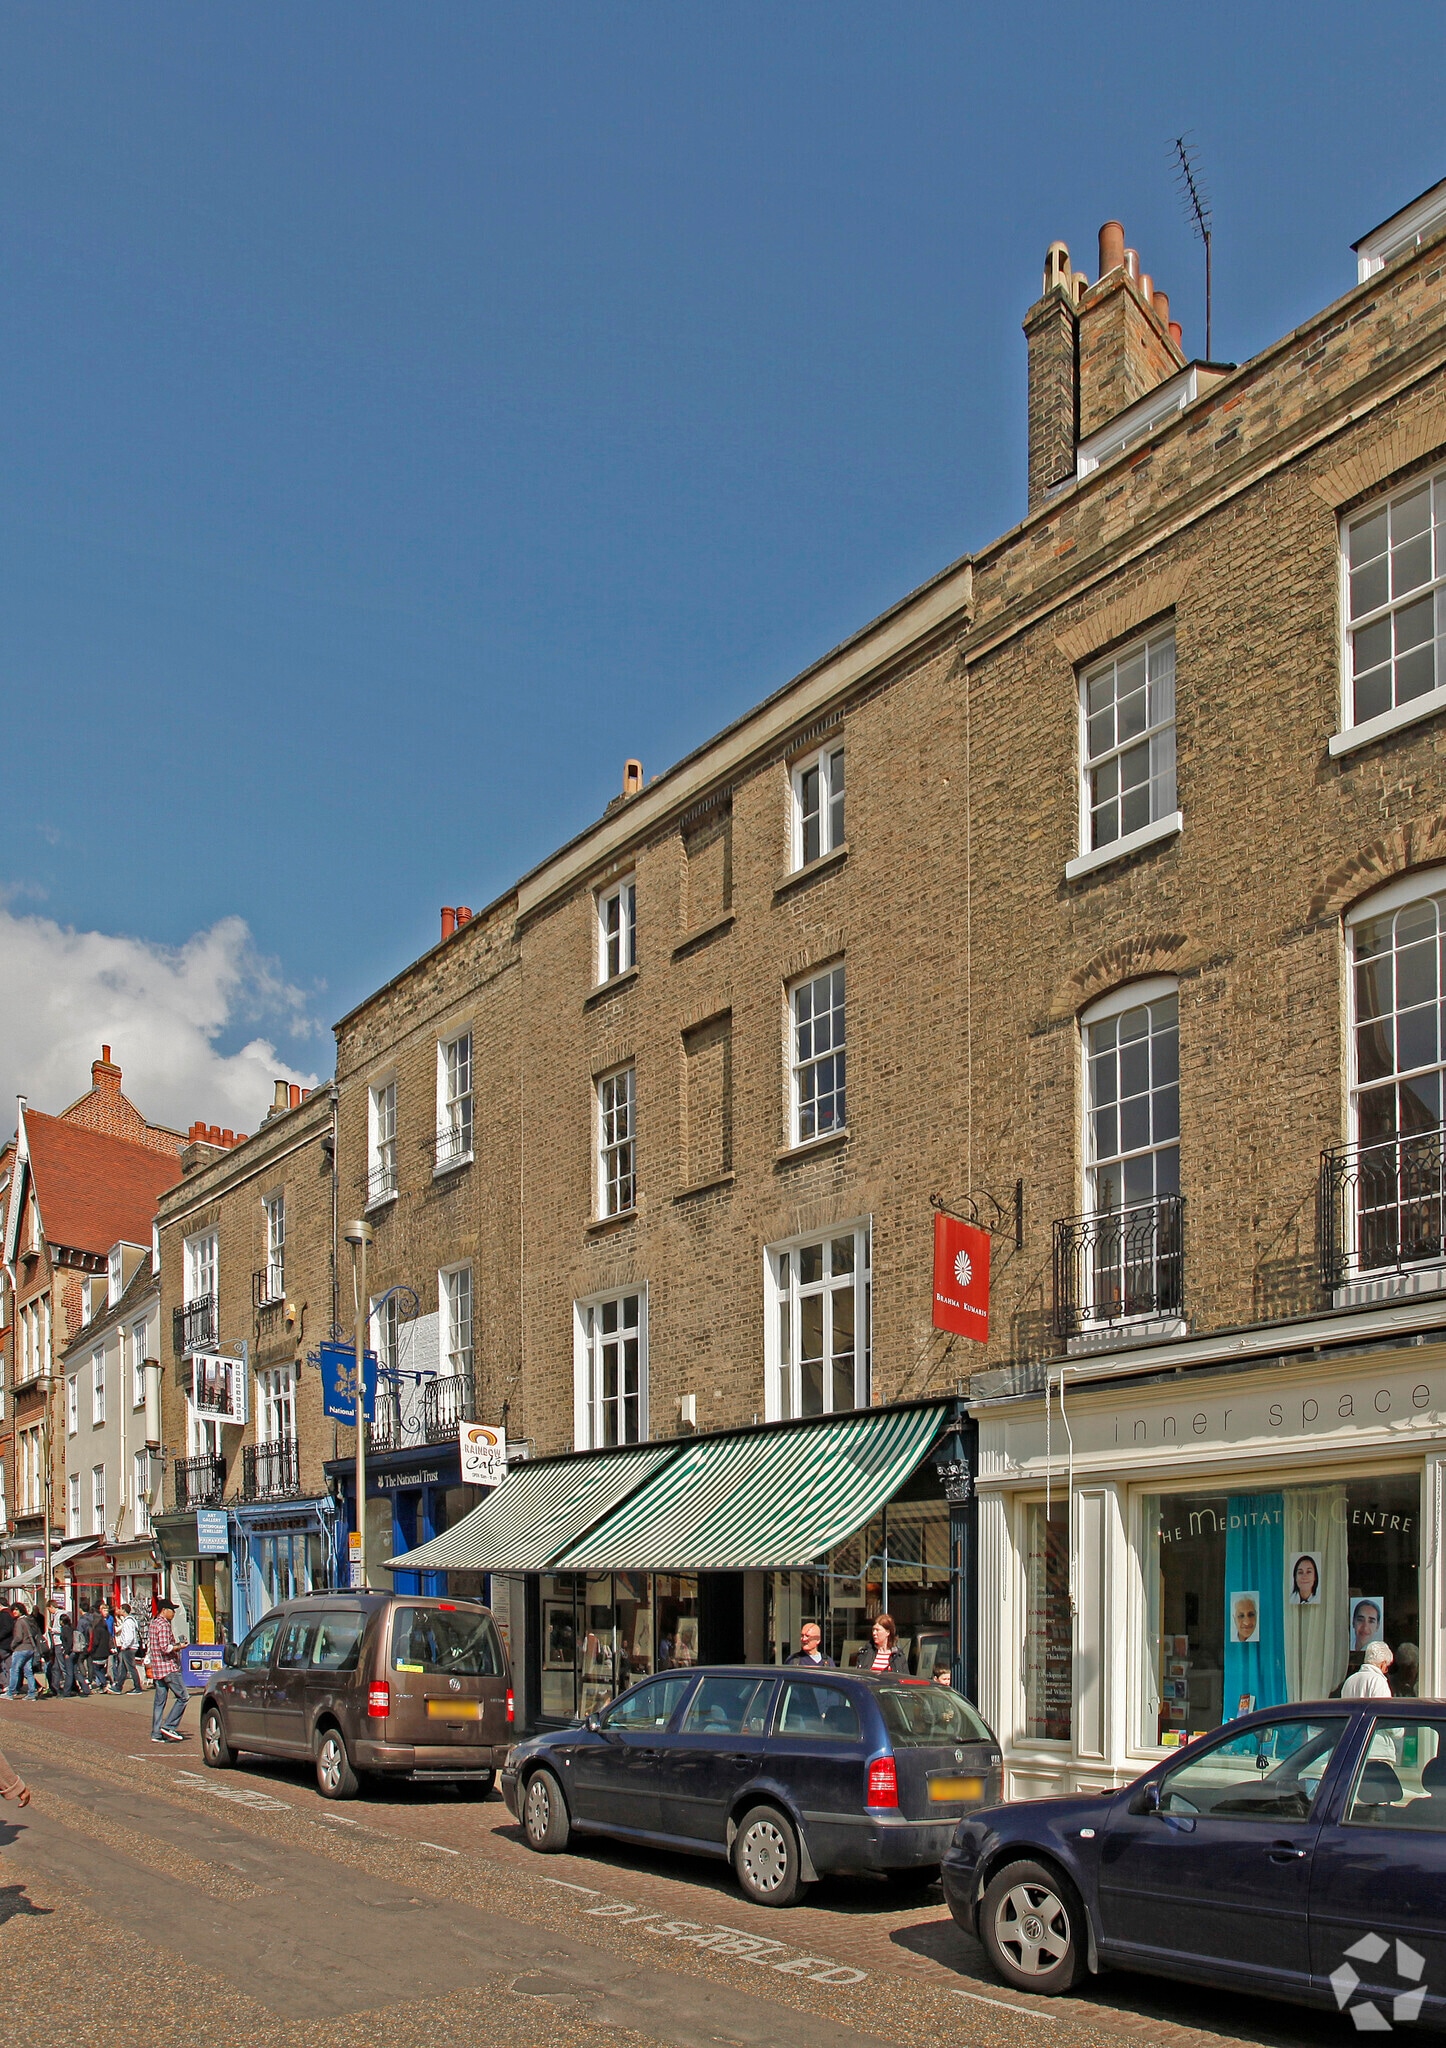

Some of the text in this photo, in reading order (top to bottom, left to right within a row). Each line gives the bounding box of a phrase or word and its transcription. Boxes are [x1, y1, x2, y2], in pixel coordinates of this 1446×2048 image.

[936, 1292, 987, 1317] BRAHMA KUMARIS
[329, 1405, 355, 1416] National
[1113, 1384, 1430, 1443] inner space
[464, 1444, 501, 1458] RAINBOW
[466, 1455, 504, 1474] Café
[384, 1469, 439, 1487] The National Trust
[1189, 1508, 1317, 1536] MEDITATON
[1330, 1497, 1412, 1533] CENTRE
[581, 1903, 869, 1985] DISABLED
